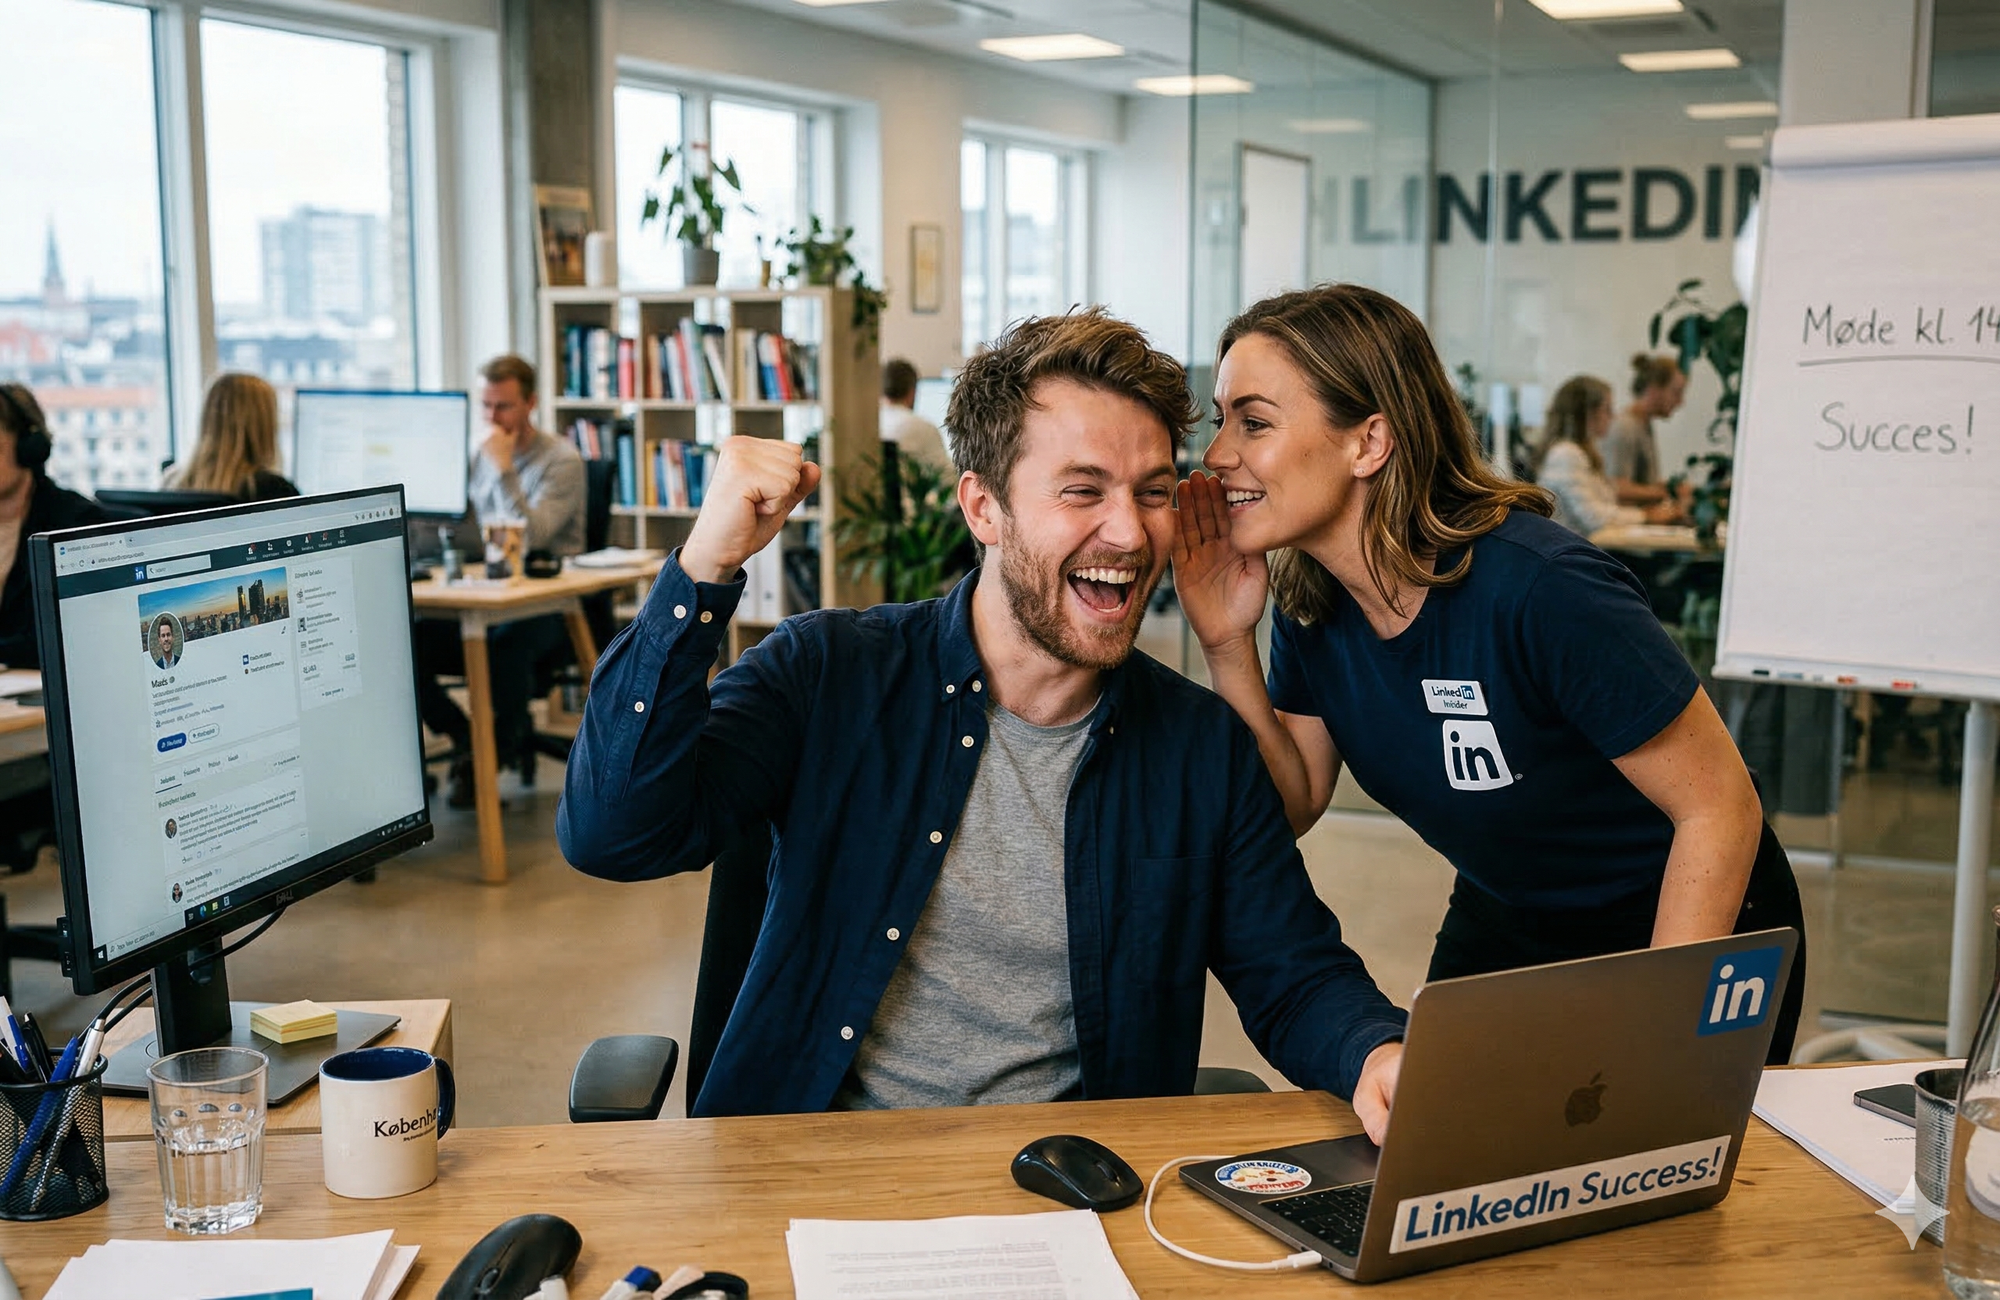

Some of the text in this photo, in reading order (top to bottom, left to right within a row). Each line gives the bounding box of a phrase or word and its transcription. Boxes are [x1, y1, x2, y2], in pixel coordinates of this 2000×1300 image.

[1803, 304, 1895, 347] Møde
[1916, 306, 1954, 345] kl.
[1814, 401, 1974, 454] Succes!
[135, 567, 145, 580] in
[1450, 730, 1501, 781] in
[1709, 964, 1765, 1024] in
[1404, 1146, 1722, 1242] LinkedIn Success!
